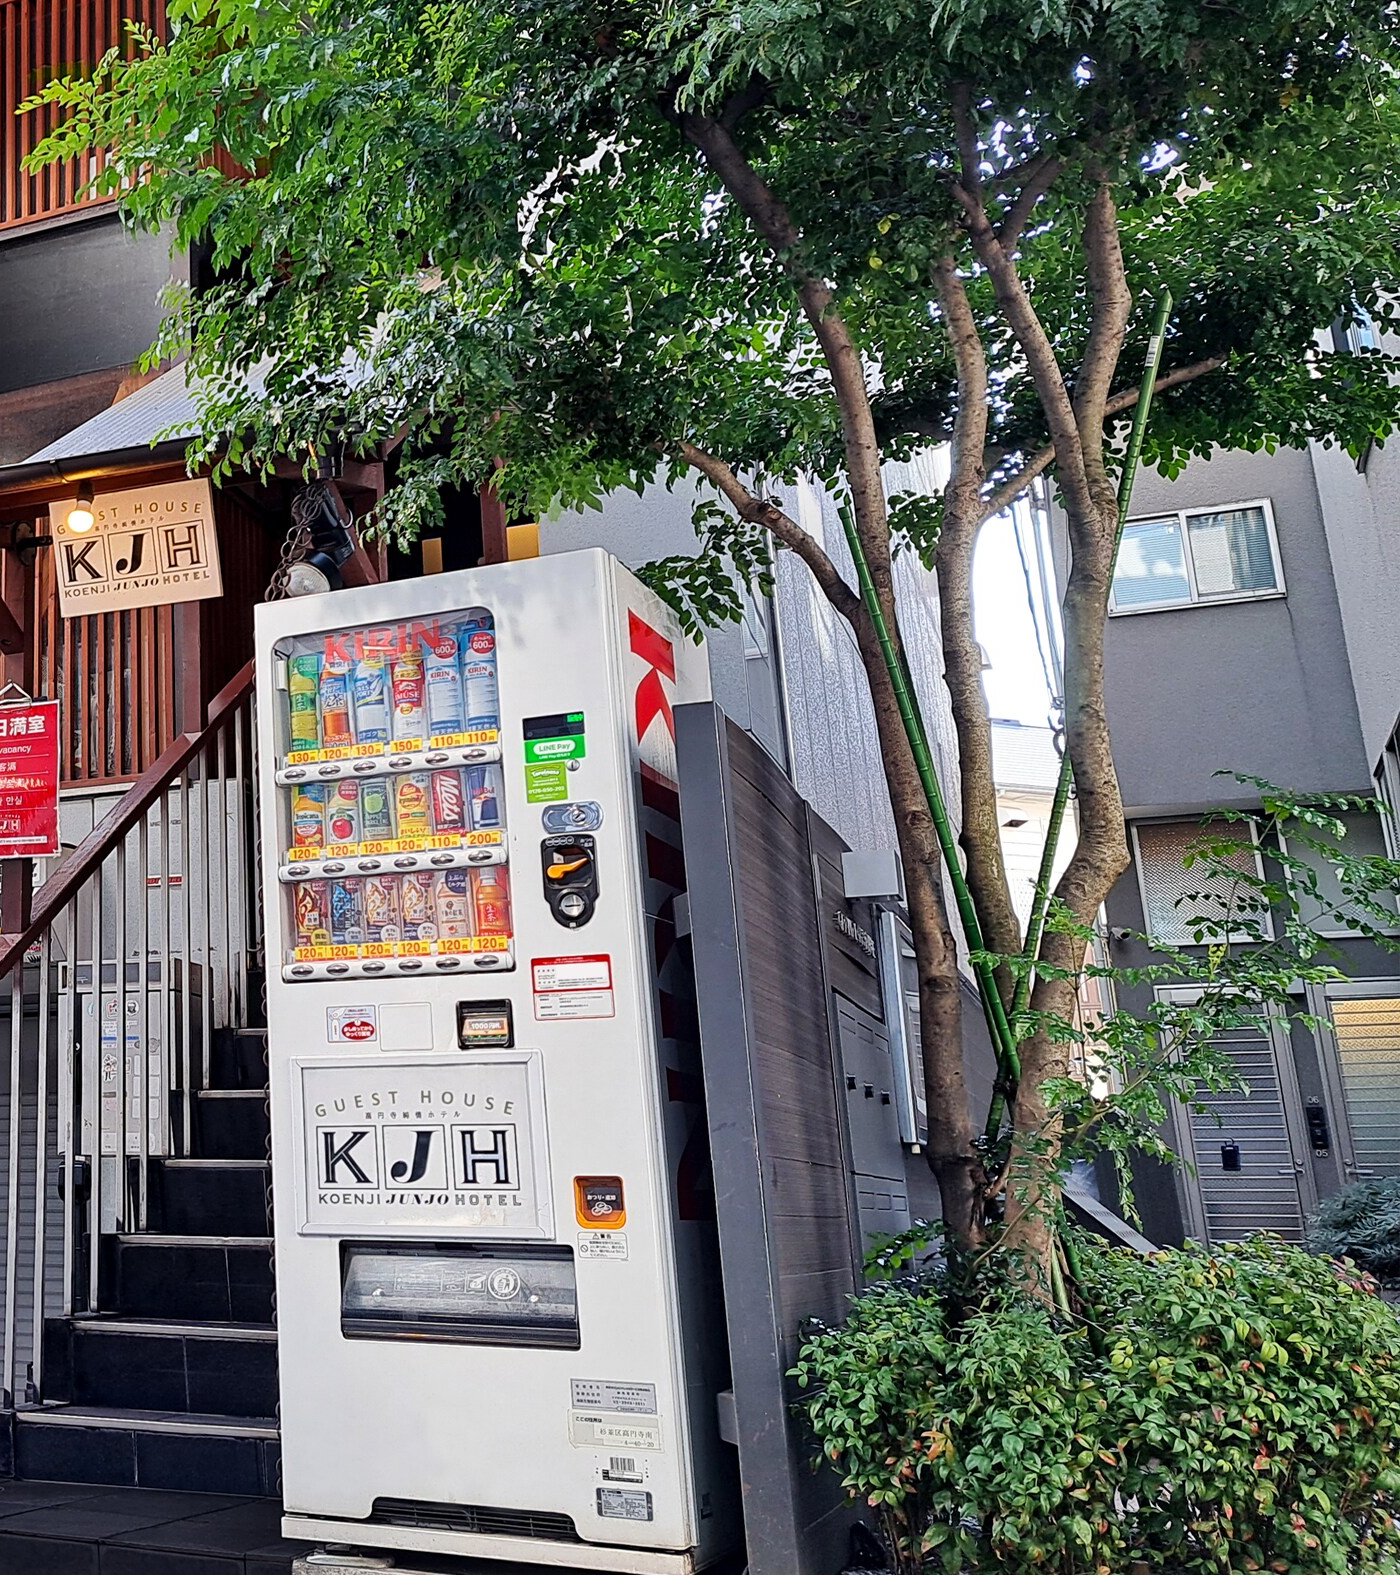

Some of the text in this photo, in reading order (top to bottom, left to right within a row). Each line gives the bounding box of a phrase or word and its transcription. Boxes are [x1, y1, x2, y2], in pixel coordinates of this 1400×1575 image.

[57, 501, 201, 535] GST HOUSE
[64, 570, 211, 599] KOENJI JUNJO HOTEL
[324, 619, 440, 664] KIRIN
[467, 666, 488, 674] KIRIN
[538, 743, 571, 752] LINE Pay
[315, 1089, 515, 1118] GUEST HOUSE
[1307, 1095, 1320, 1104] 06
[365, 1110, 461, 1120] 高円寺純情ホテル
[1315, 1149, 1329, 1157] 05
[318, 1192, 522, 1207] KOENJI JUNJO HOTEL
